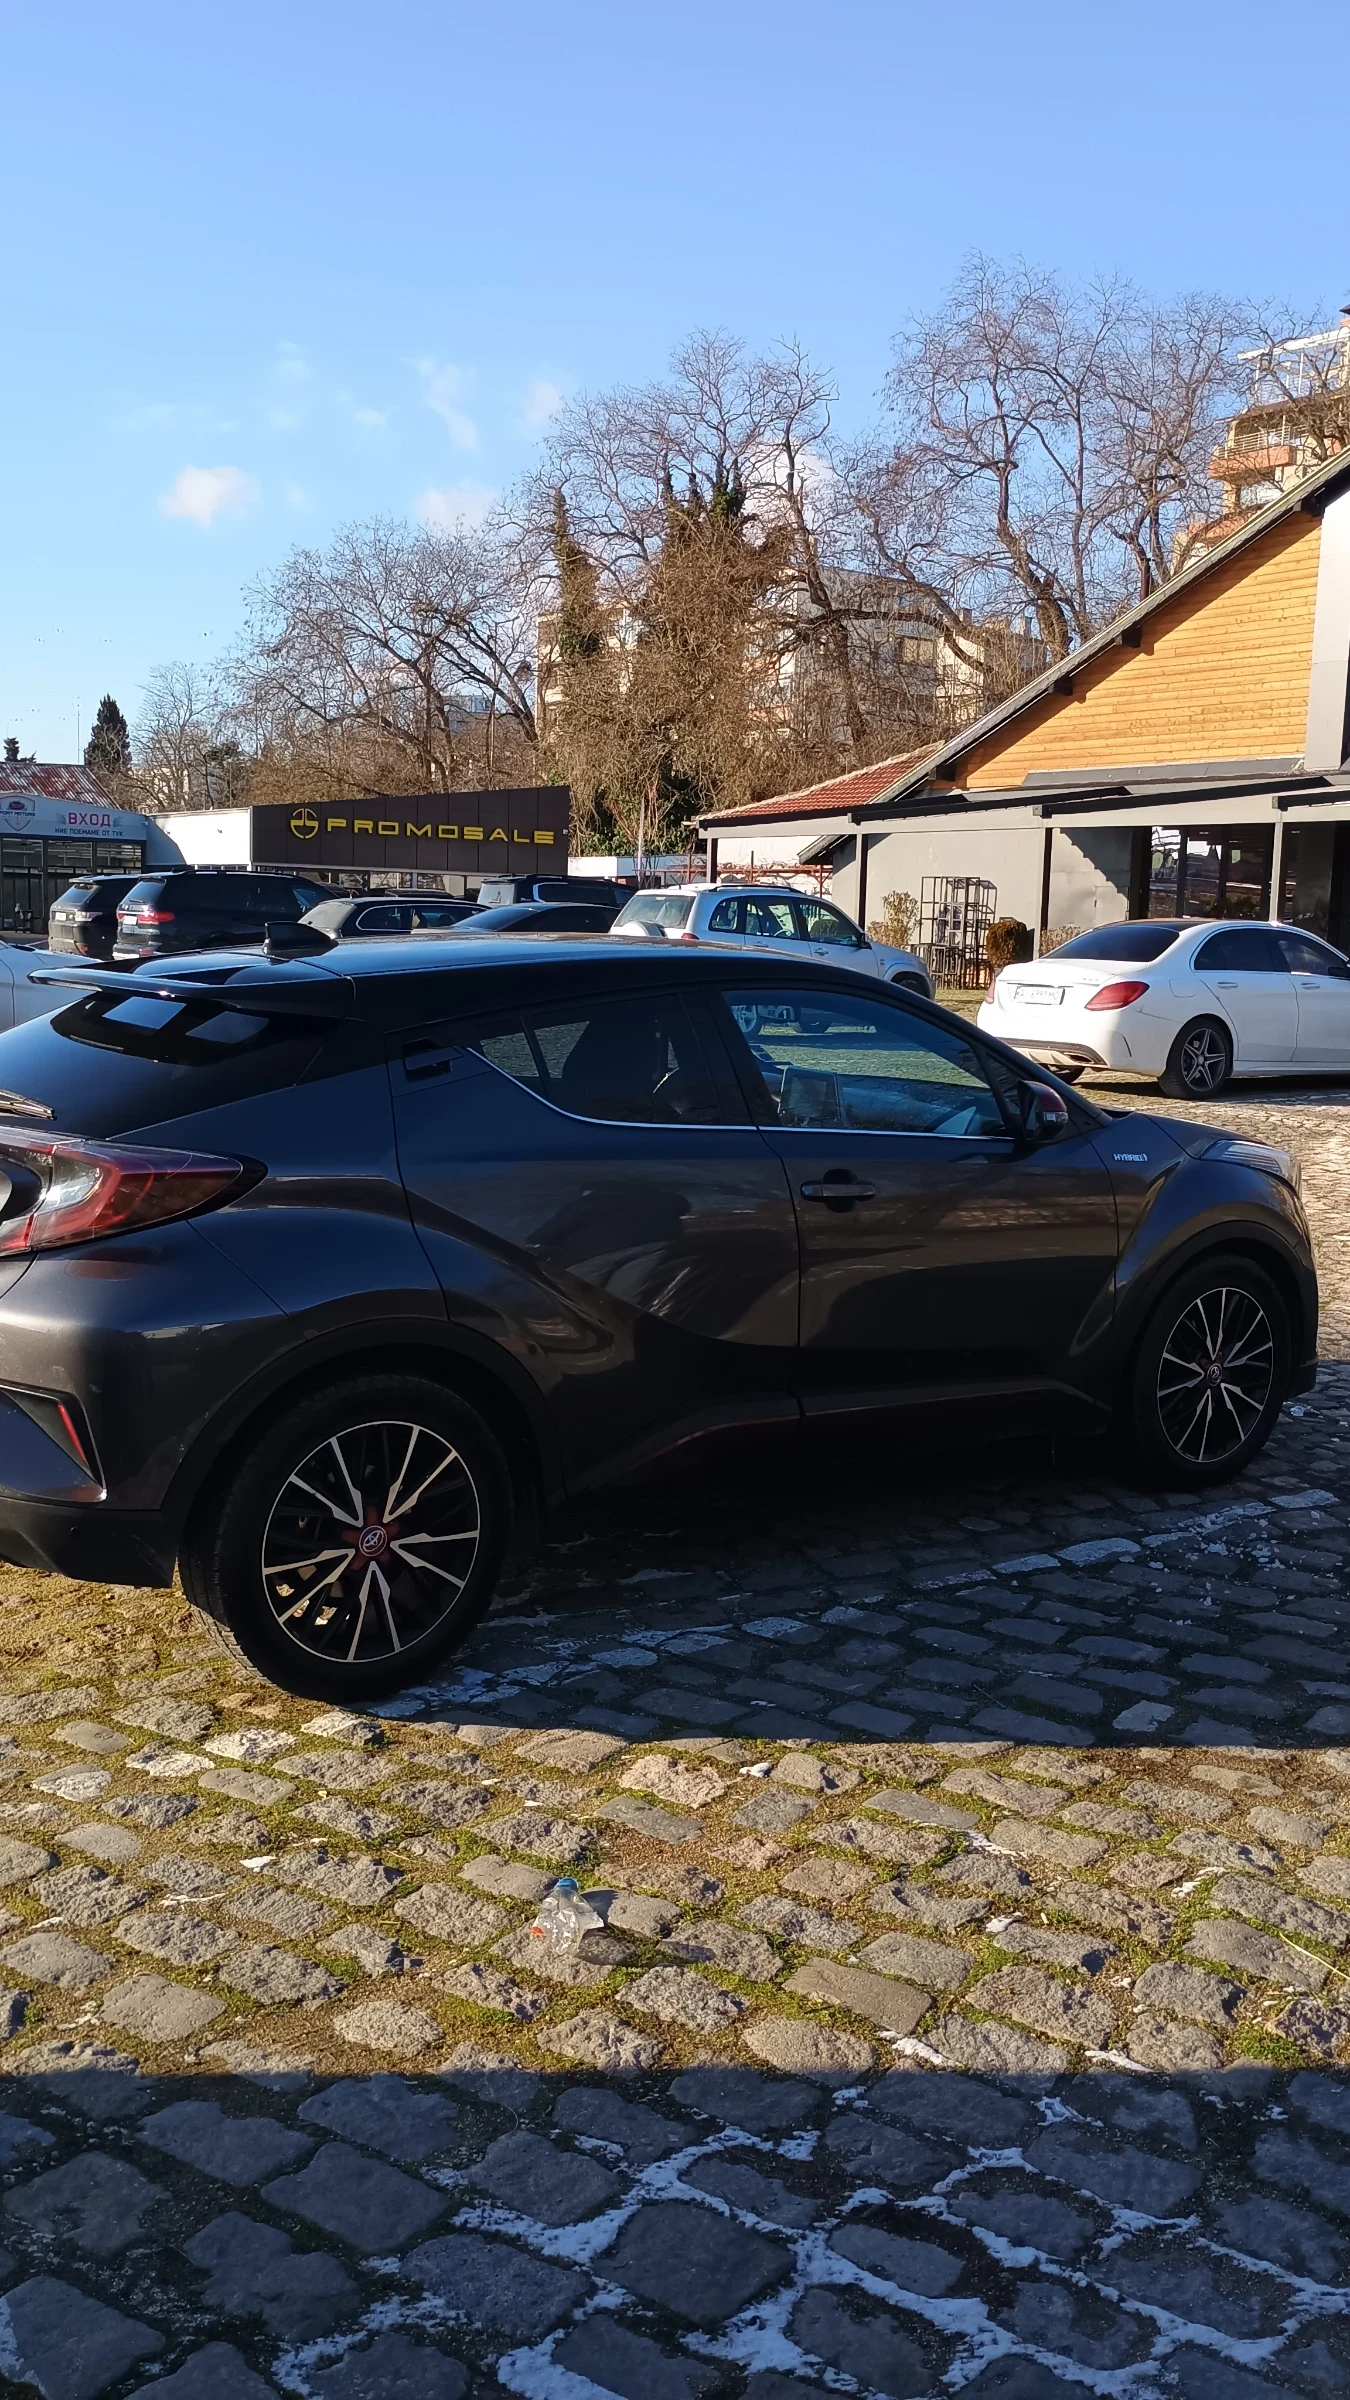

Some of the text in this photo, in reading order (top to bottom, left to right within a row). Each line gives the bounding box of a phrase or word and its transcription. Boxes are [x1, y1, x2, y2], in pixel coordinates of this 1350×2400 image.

[68, 812, 111, 828] ВХОД
[69, 828, 100, 836] ПОЕМАМЕ
[327, 817, 555, 845] PROMOSALE
[1113, 1153, 1143, 1162] HYBRID
